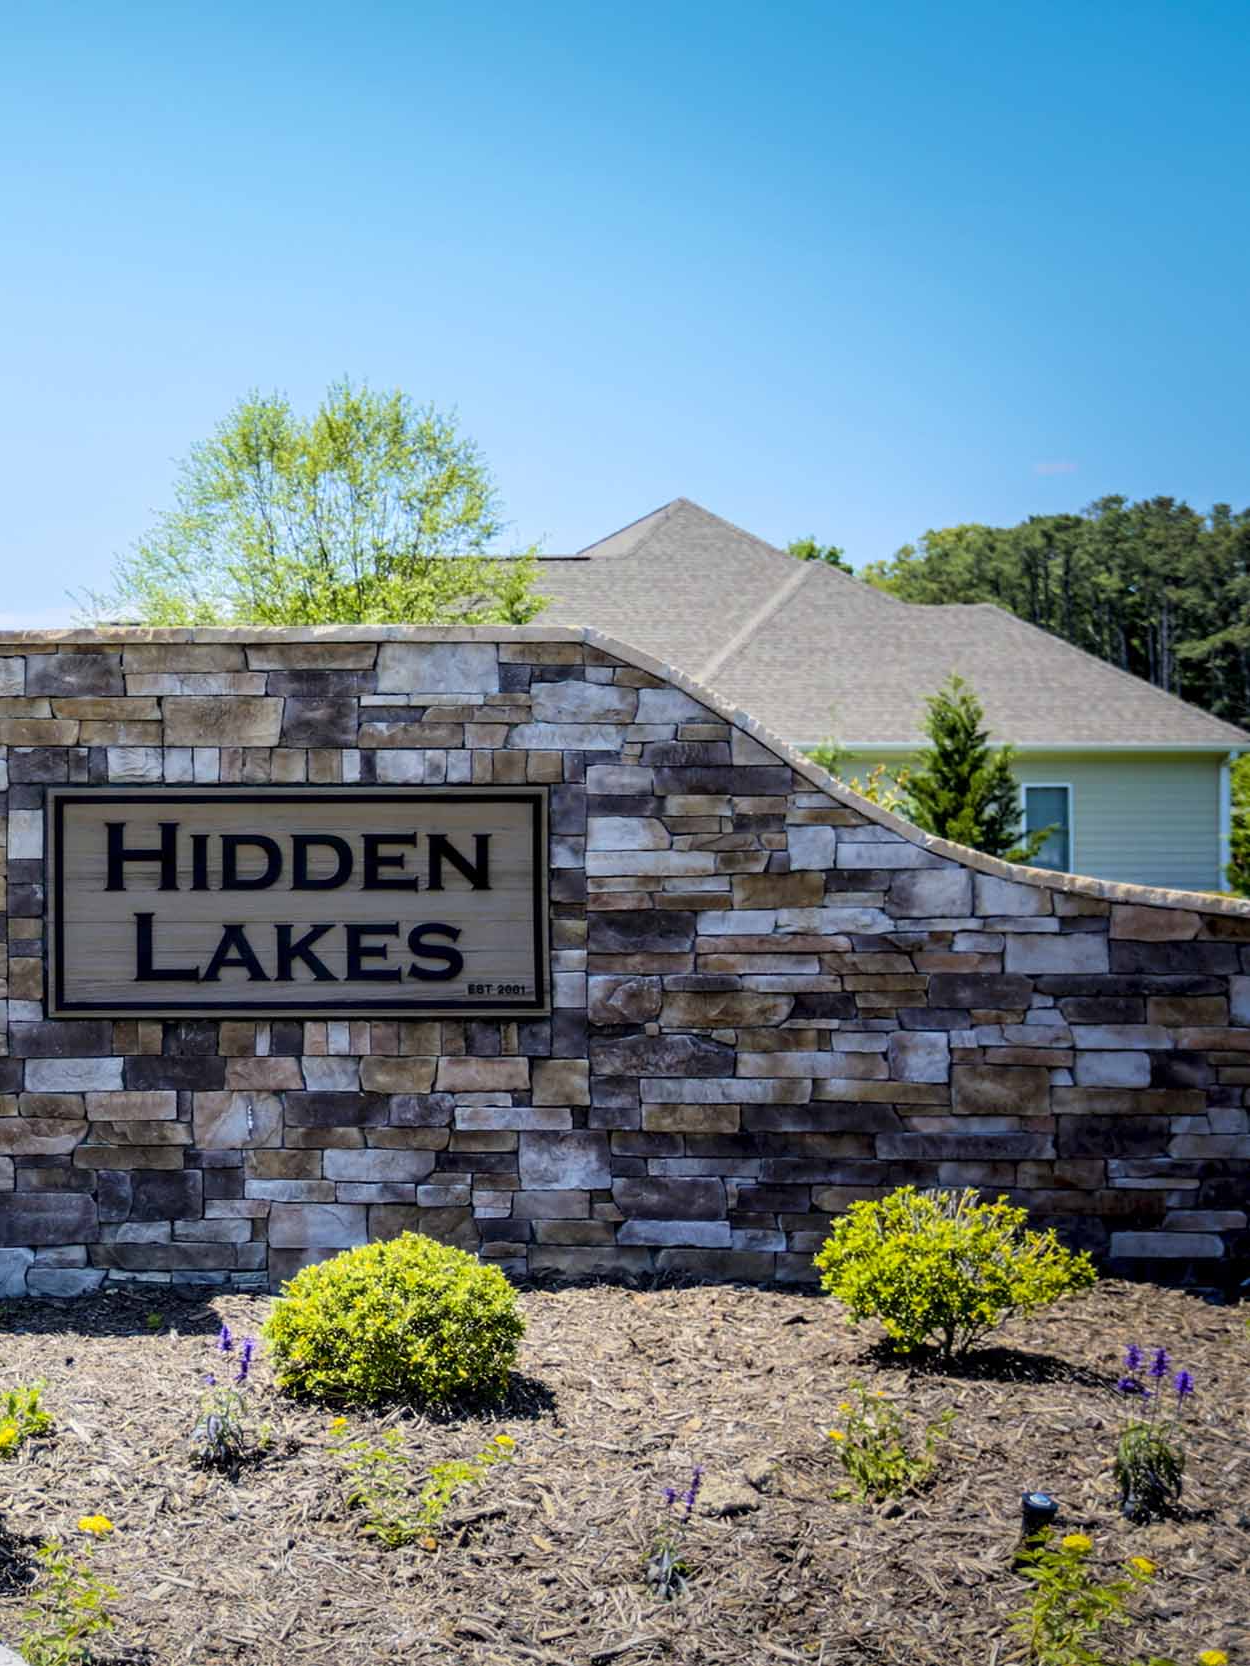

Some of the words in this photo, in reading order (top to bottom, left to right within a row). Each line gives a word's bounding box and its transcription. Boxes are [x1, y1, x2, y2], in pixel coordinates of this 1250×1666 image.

[104, 822, 493, 893] HIDDEN
[133, 912, 464, 983] LAKES
[468, 983, 492, 994] EST
[496, 984, 526, 994] 2001
